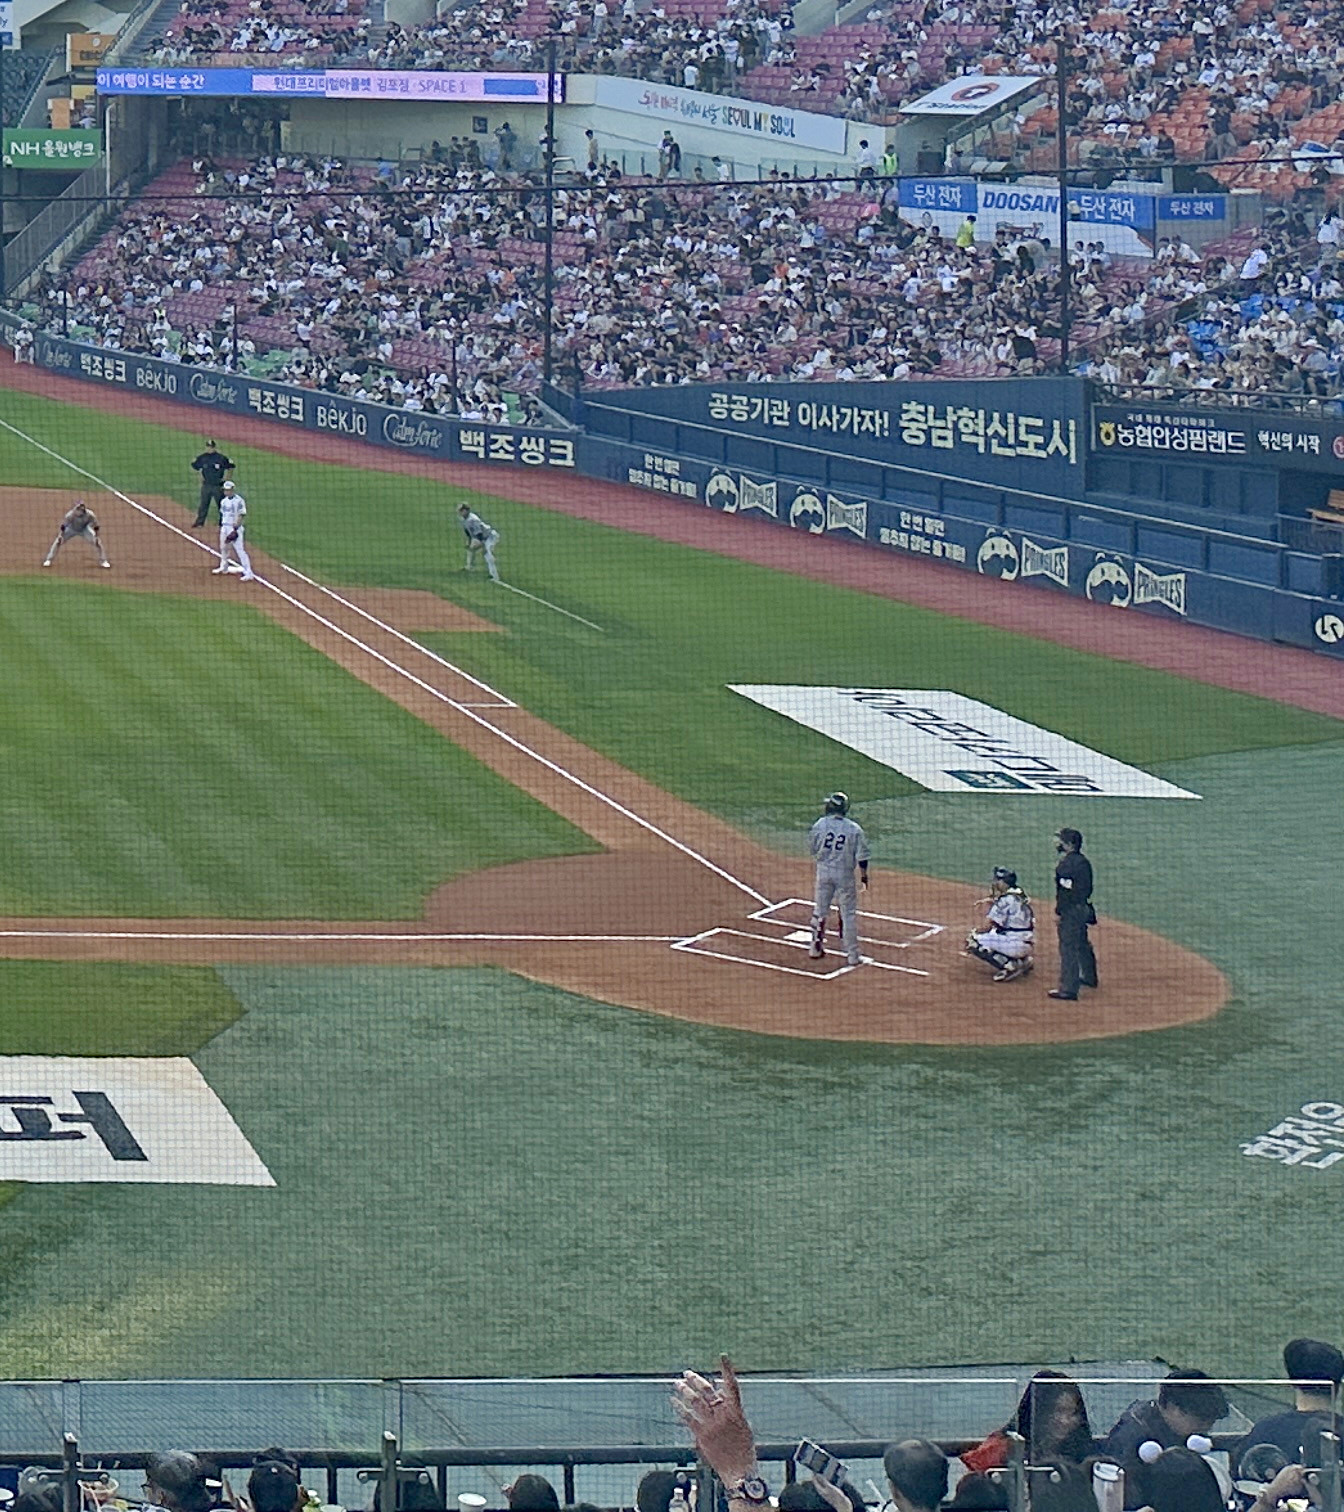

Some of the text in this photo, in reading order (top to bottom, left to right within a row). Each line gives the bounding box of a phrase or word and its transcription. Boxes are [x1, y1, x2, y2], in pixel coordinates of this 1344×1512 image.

[152, 74, 176, 89] 되는
[180, 74, 205, 89] 순간
[11, 140, 95, 157] NH 올원뱅크
[983, 191, 1060, 213] DOOSAN
[1080, 195, 1106, 219] 두산
[80, 353, 126, 382] 백조씽크
[248, 387, 304, 422] 백조씽크
[460, 429, 575, 467] 백조씽크
[708, 393, 1076, 464] 공공기관 이사가자! 충남혁신도시
[1117, 424, 1320, 454] 농협안성팜랜드 혁신의 시작
[823, 832, 846, 850] 22
